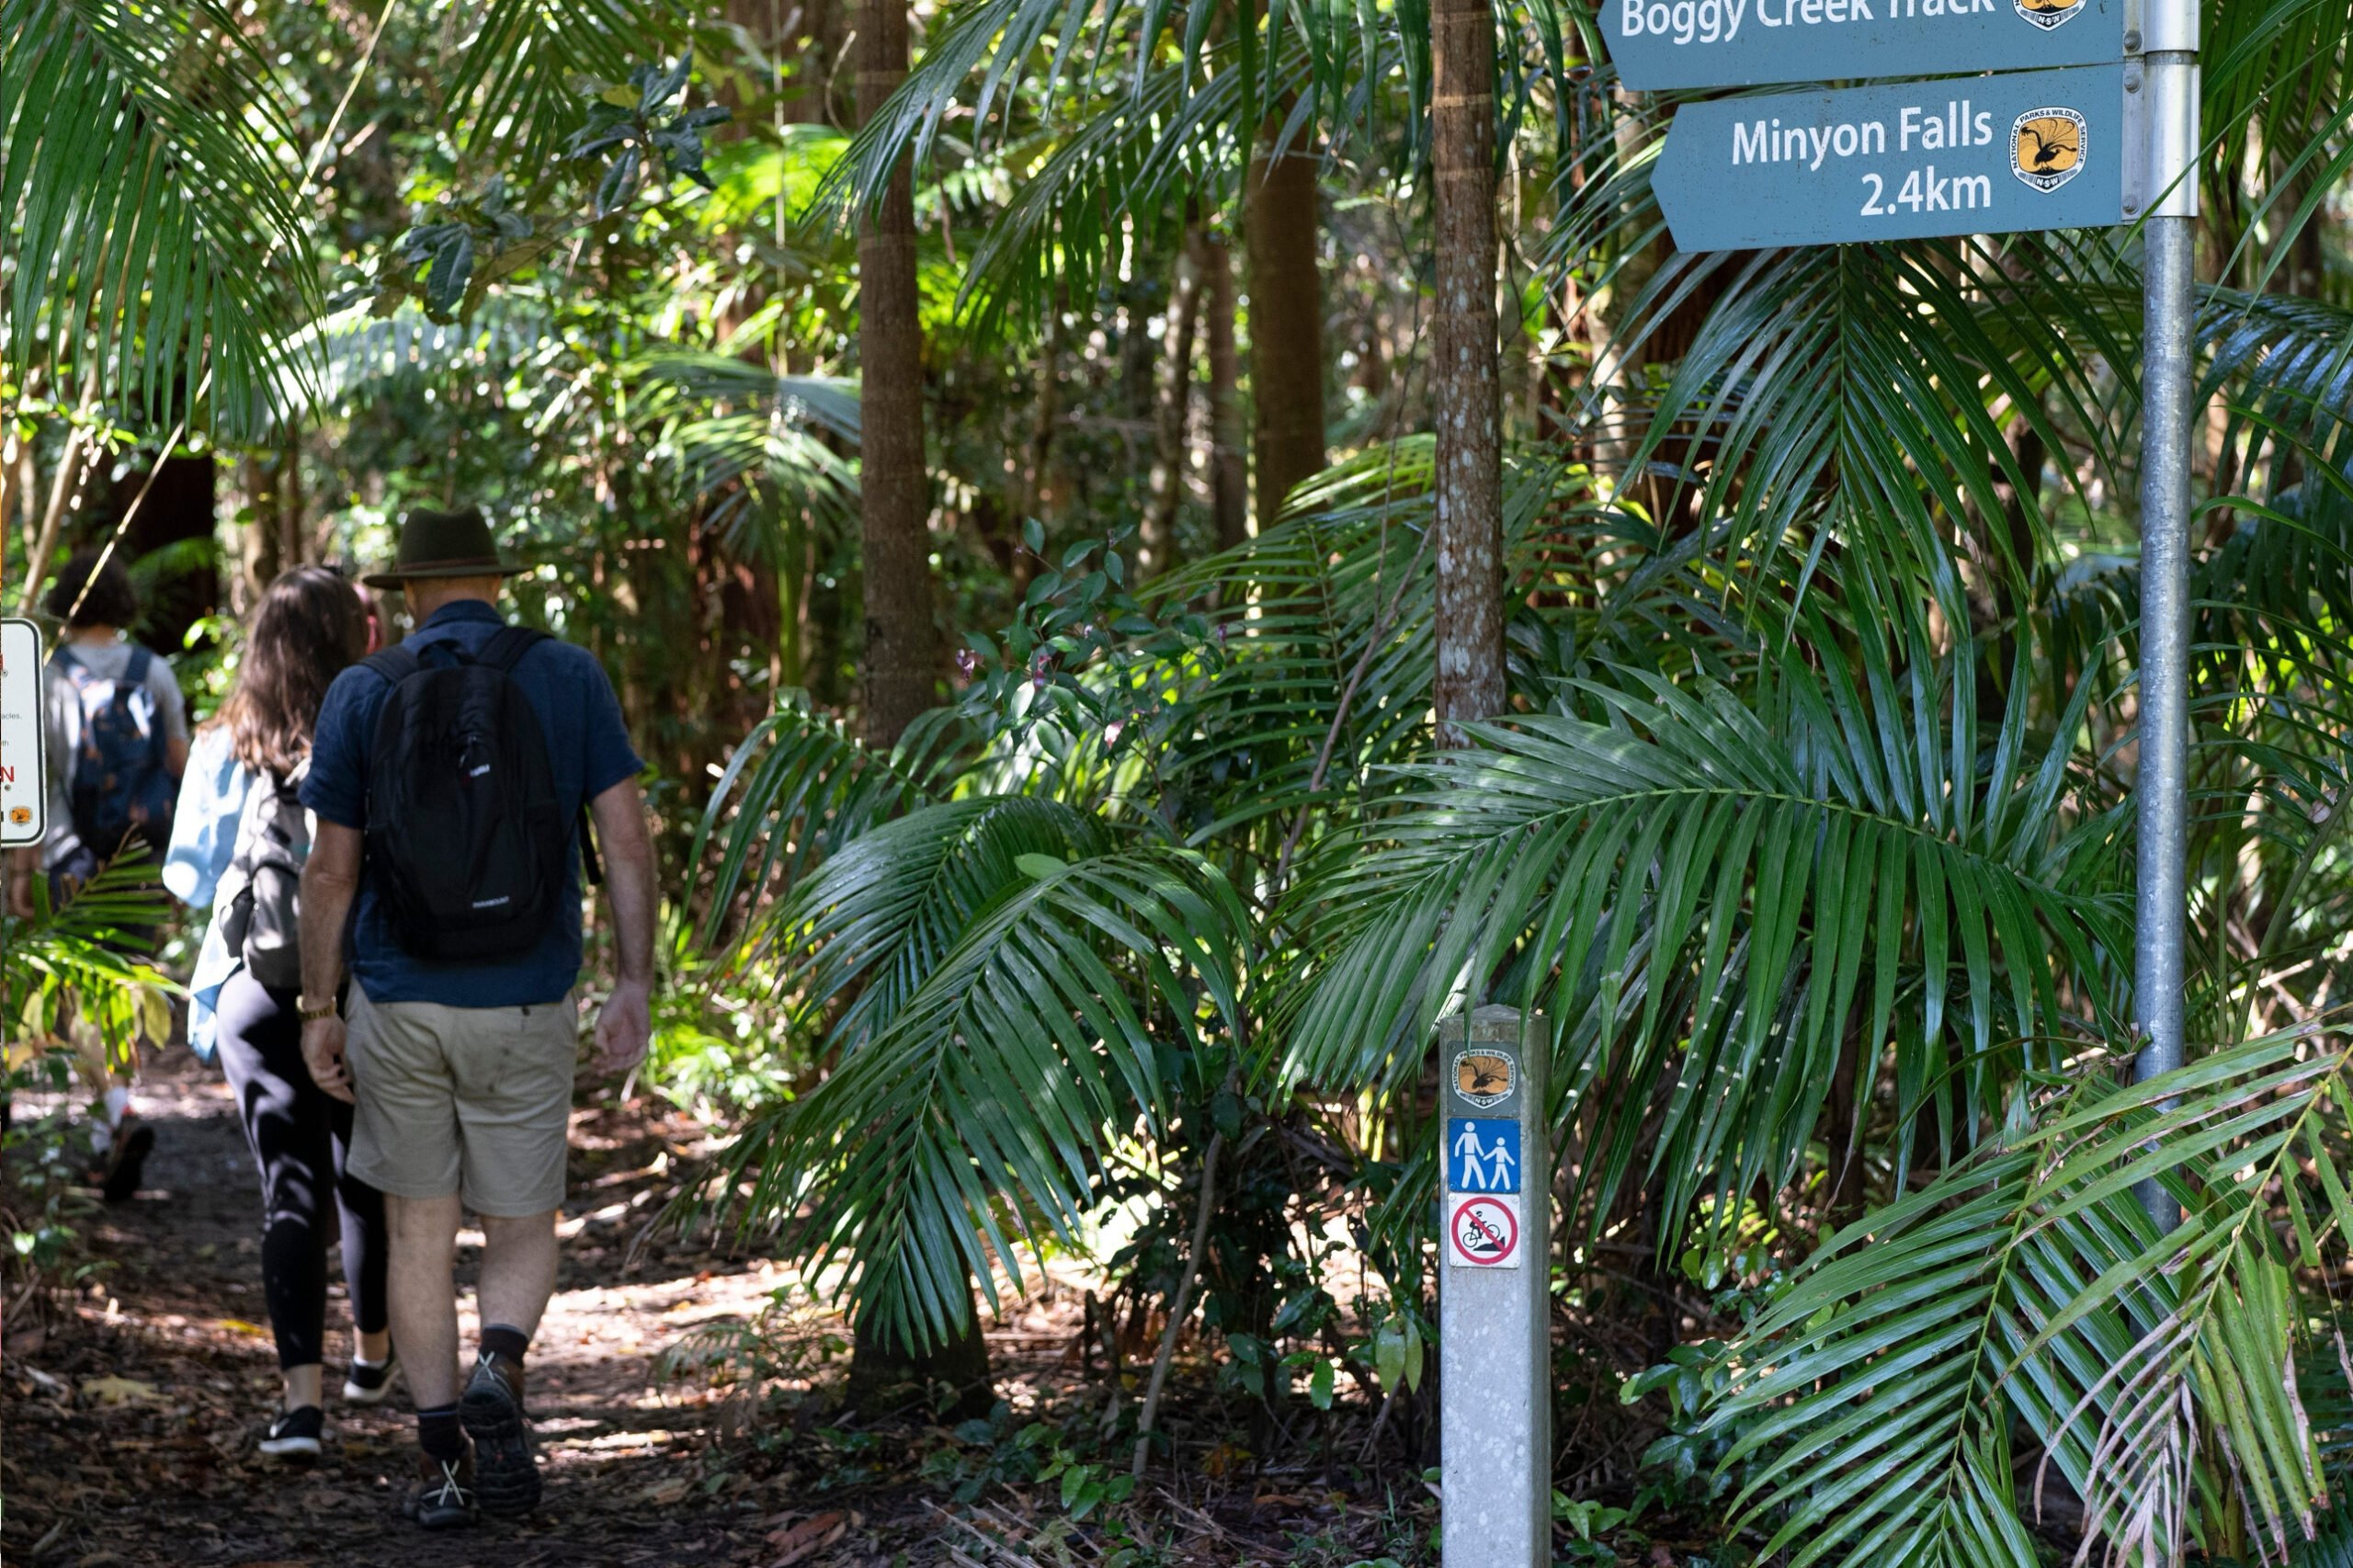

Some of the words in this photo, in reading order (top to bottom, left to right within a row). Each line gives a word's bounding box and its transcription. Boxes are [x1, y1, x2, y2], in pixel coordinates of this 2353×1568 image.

[1622, 0, 1746, 45] Boggy
[1733, 118, 1884, 172] Minyon
[1900, 100, 1993, 151] Falls
[2011, 124, 2020, 168] NATIONAL
[2019, 110, 2045, 123] PARKS
[2052, 110, 2084, 123] WILDLIFE
[2078, 126, 2086, 163] SERVICE
[1860, 165, 1991, 216] 2.4km
